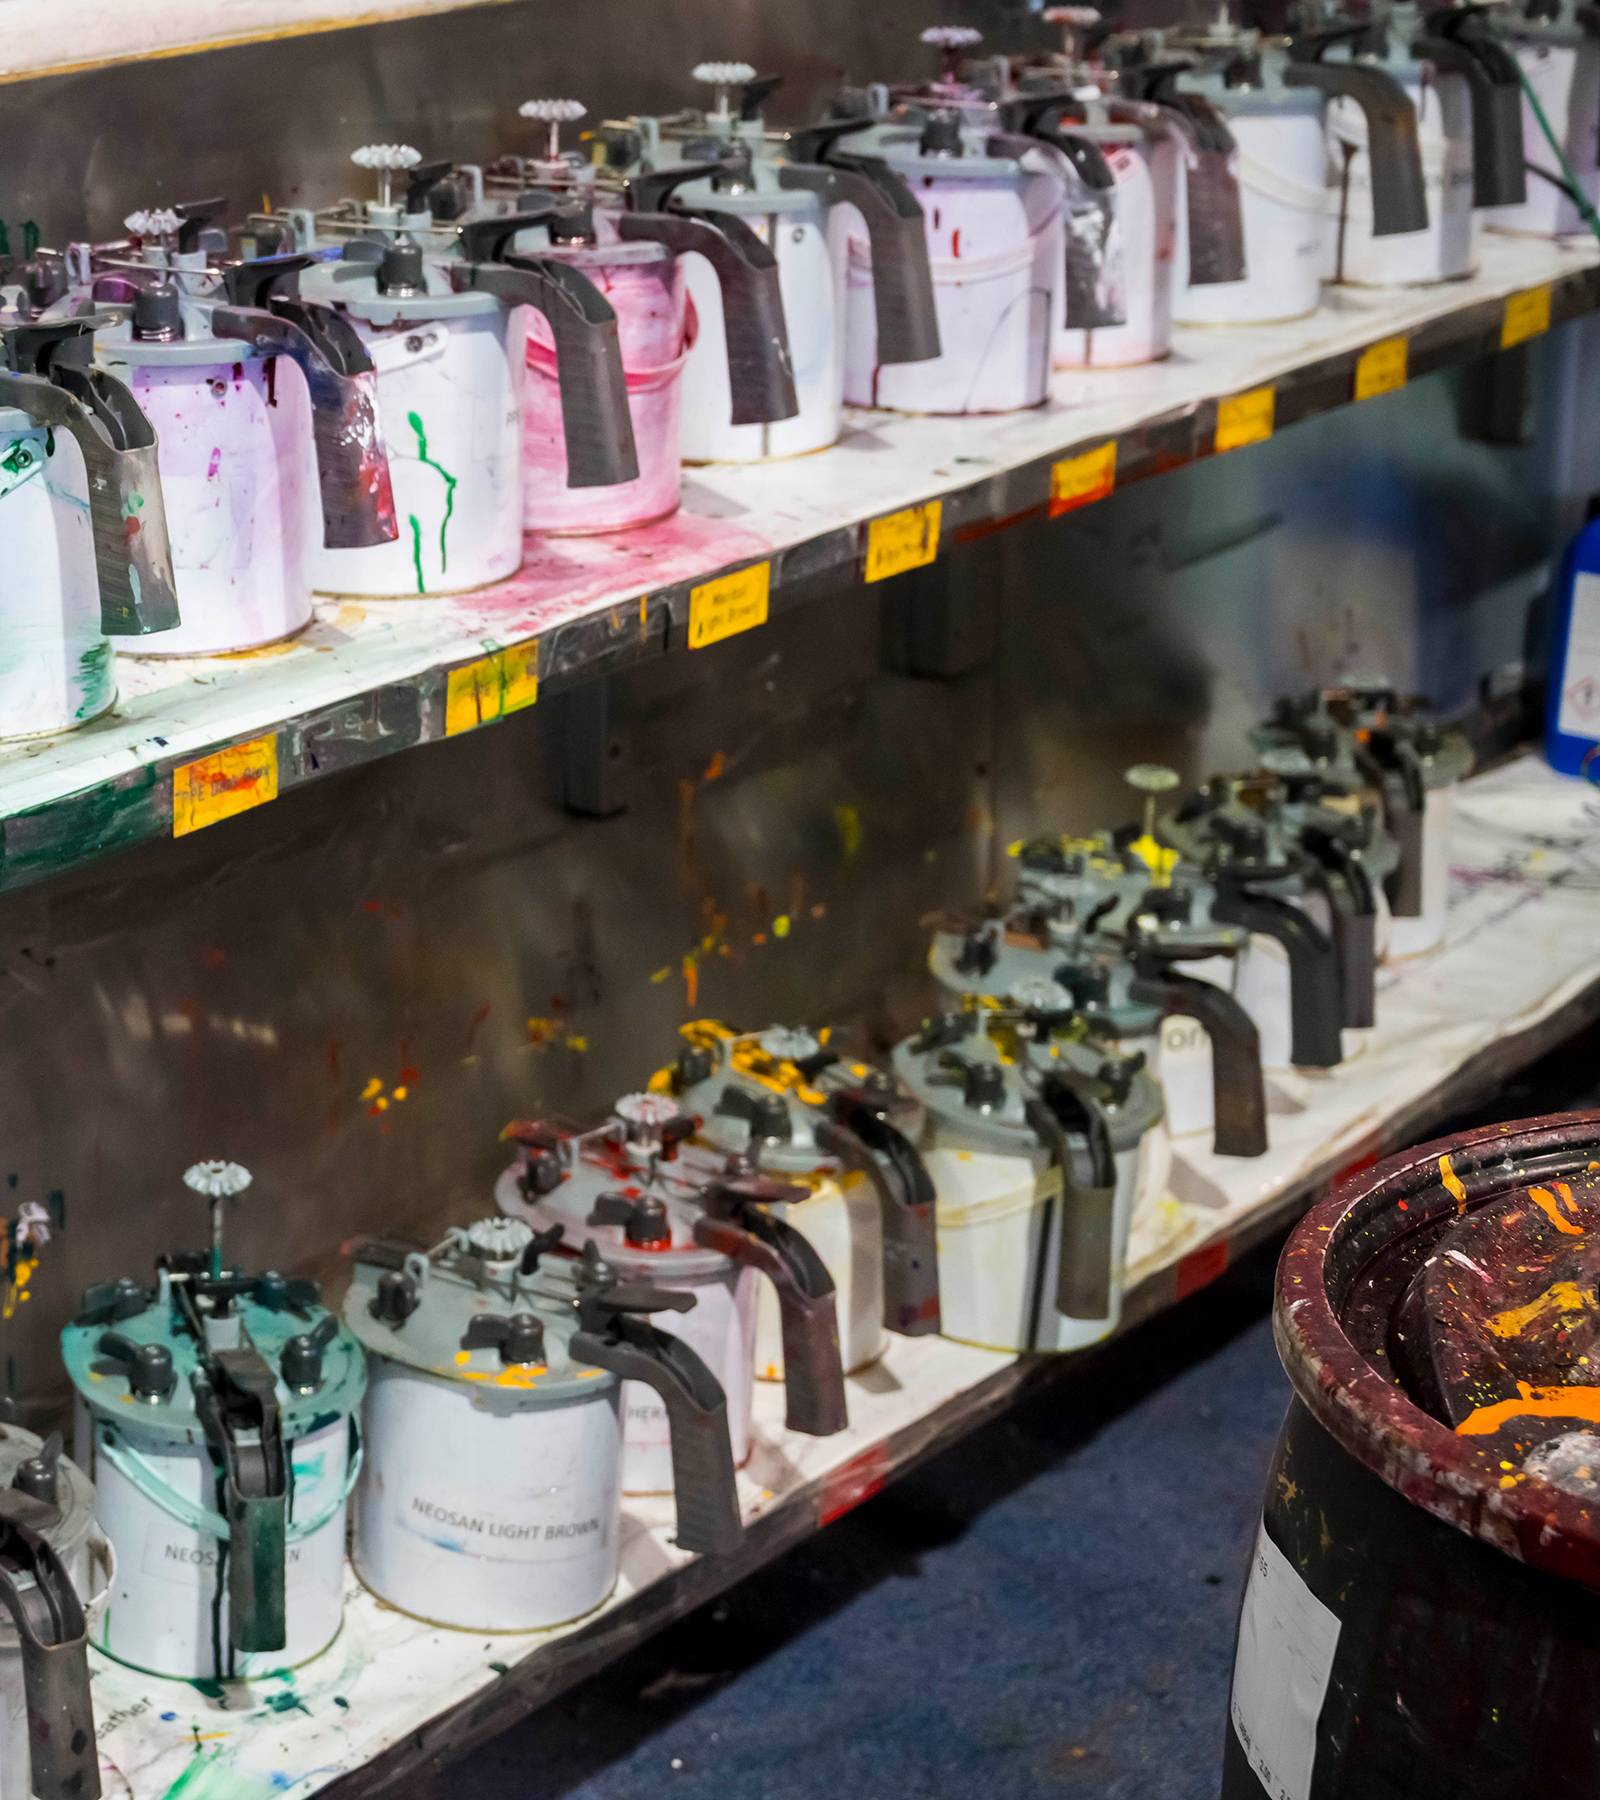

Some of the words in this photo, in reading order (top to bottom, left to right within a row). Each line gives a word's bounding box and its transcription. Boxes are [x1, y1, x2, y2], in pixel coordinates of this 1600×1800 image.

[412, 1497, 483, 1533] NEOSAN
[488, 1522, 541, 1541] LIGHT
[544, 1517, 599, 1540] BROWN
[96, 1695, 153, 1740] eather
